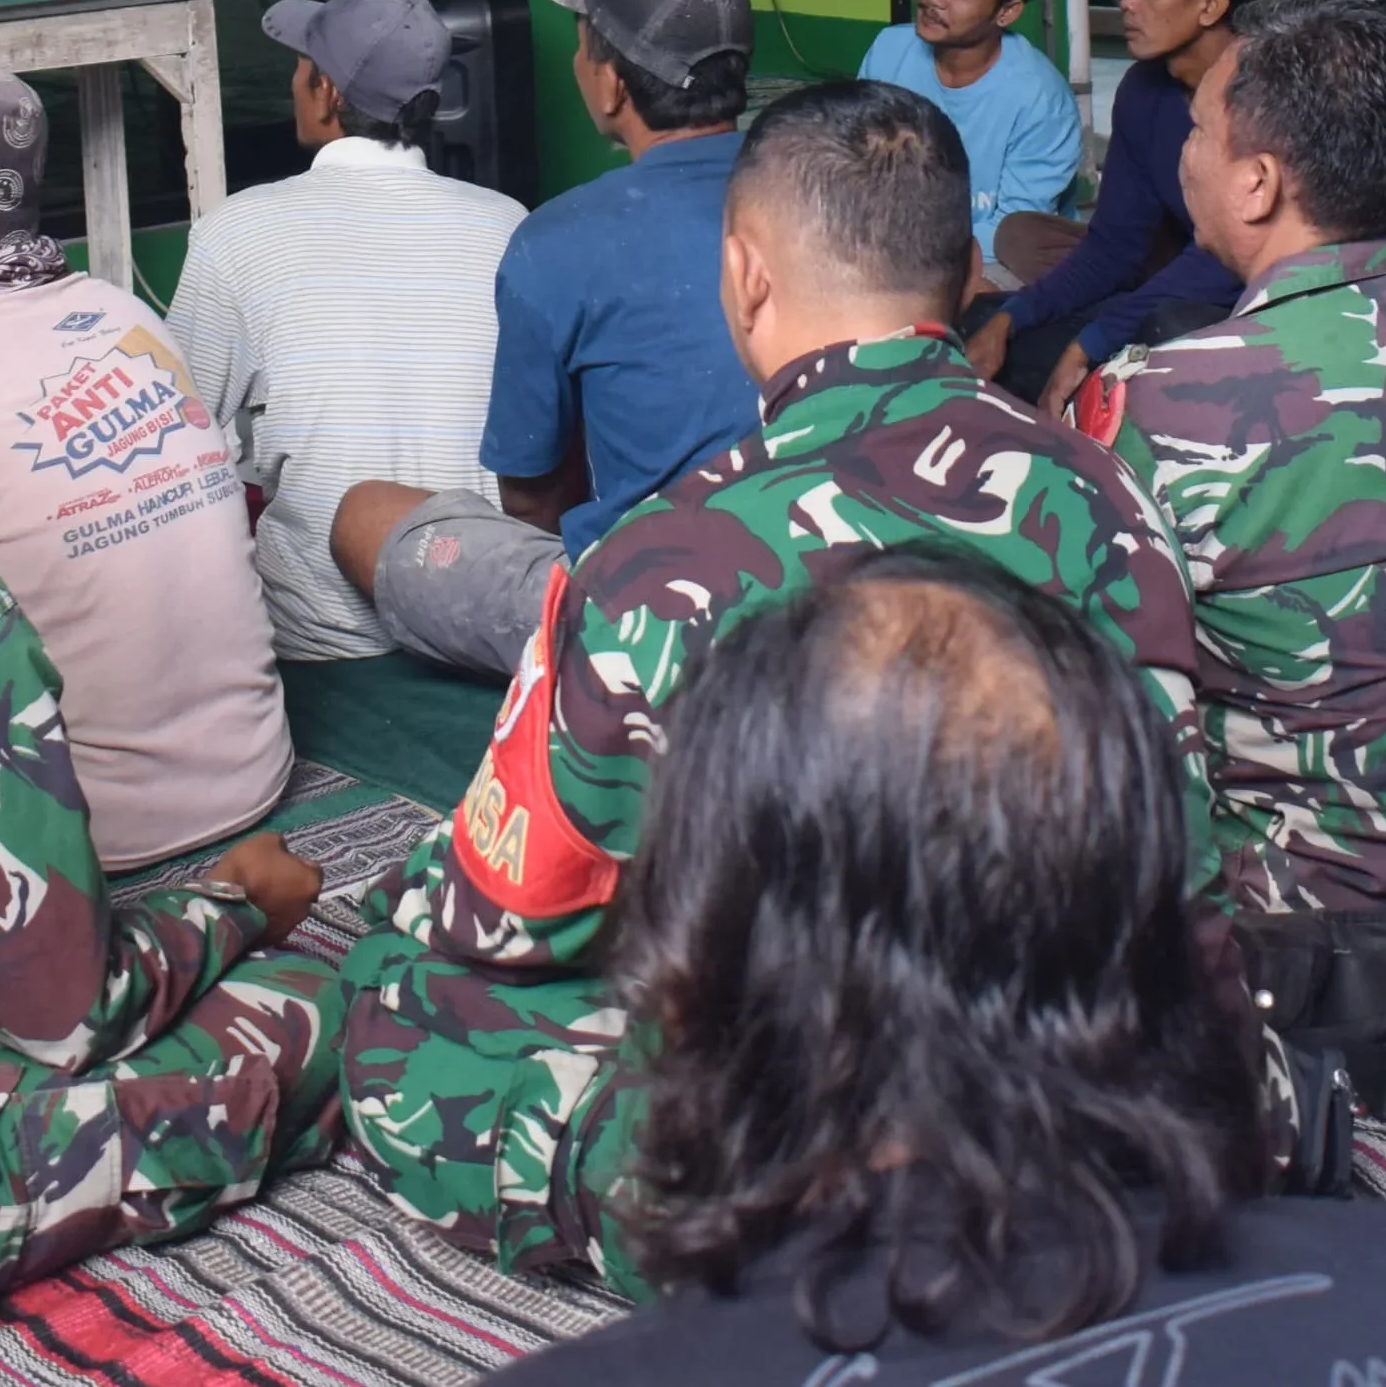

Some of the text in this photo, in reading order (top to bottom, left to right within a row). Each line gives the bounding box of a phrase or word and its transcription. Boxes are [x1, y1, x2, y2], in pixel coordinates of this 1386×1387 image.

[37, 362, 96, 421] PAKET
[51, 366, 134, 443] ANTI
[65, 380, 176, 460] GULMA
[107, 426, 148, 458] JAGUNG
[63, 509, 136, 544] GULMA
[138, 481, 194, 515] HANCUR
[67, 521, 150, 559] JAGUNG
[152, 498, 204, 528] TUMBUH
